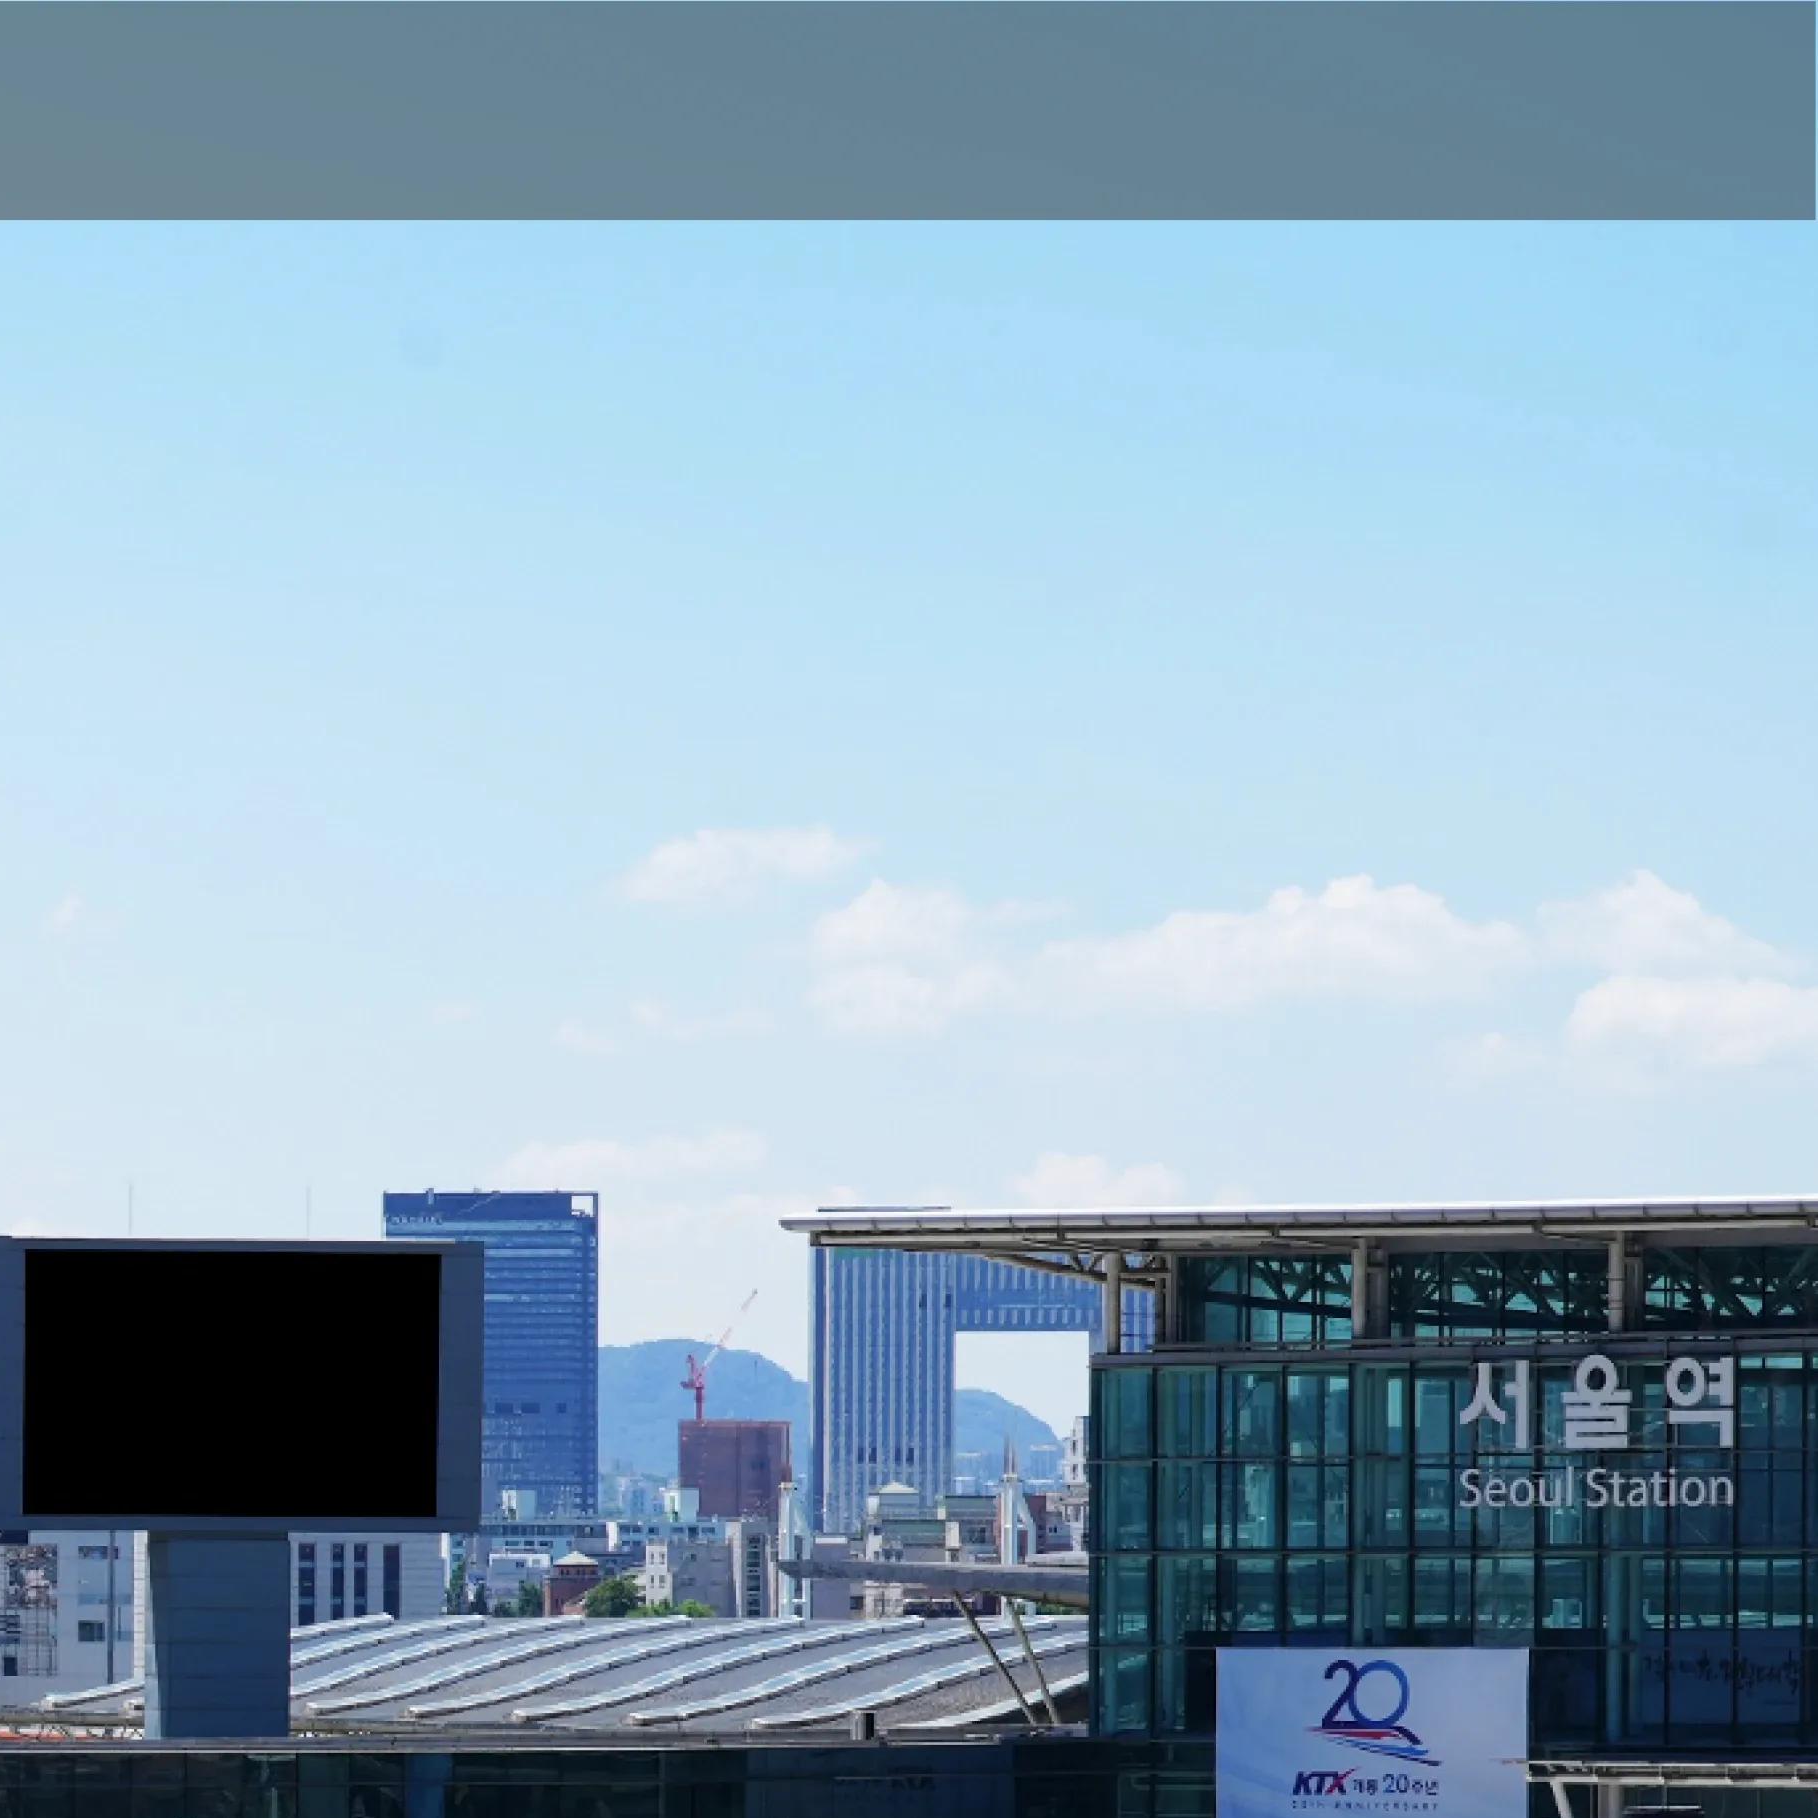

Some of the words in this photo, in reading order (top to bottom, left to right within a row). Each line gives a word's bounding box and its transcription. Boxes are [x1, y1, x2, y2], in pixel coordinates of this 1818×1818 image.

[1459, 1354, 1734, 1449] 서울역
[1458, 1466, 1574, 1508] Seoul
[1586, 1467, 1734, 1507] Station
[1320, 1658, 1411, 1730] 20
[1292, 1768, 1356, 1796] KTX
